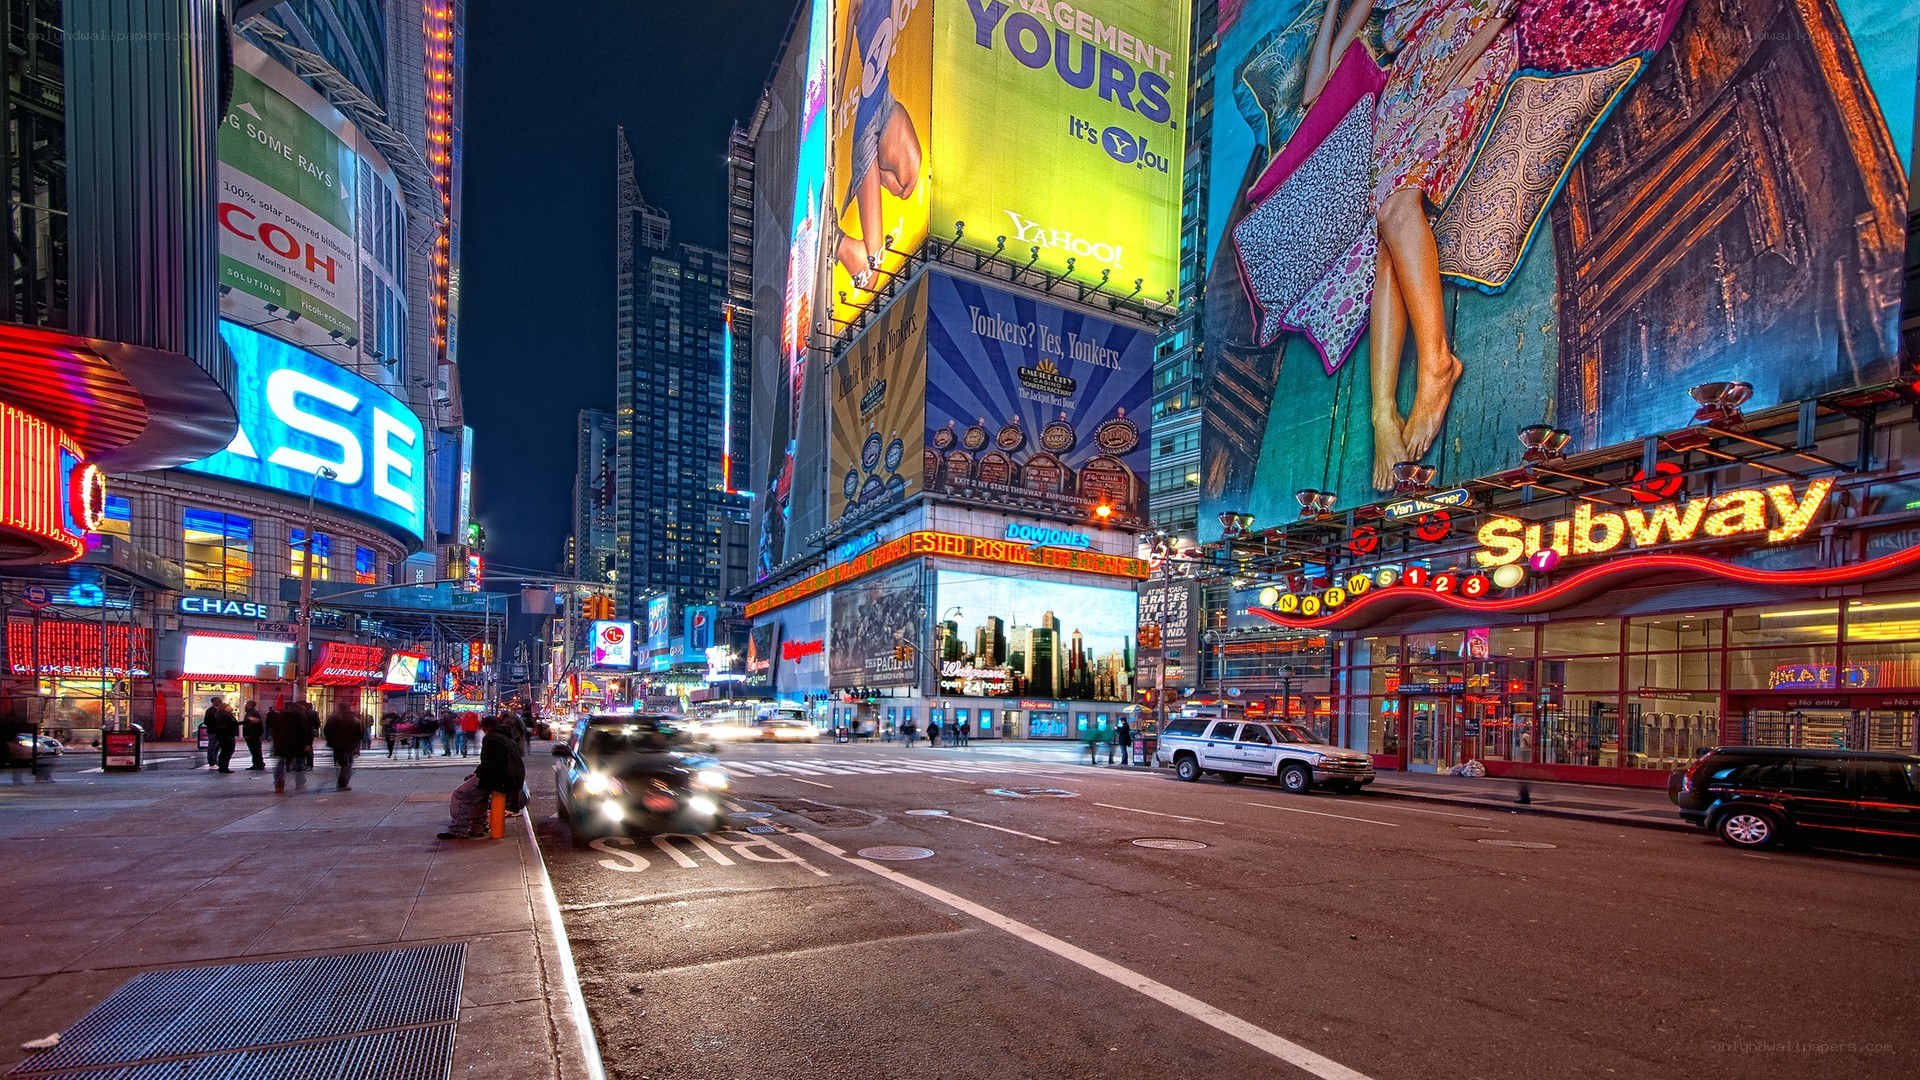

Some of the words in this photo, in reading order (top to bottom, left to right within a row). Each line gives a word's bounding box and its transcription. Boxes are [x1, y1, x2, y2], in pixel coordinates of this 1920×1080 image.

[1005, 0, 1175, 79] NAGEMENT.
[967, 0, 1177, 130] YOURS.
[1069, 115, 1098, 145] It's
[246, 123, 292, 161] SOME
[298, 154, 332, 188] RAYS
[223, 181, 256, 204] 100%
[259, 200, 283, 217] solar
[285, 214, 320, 240] powered
[321, 234, 353, 262] billboard.
[1004, 209, 1123, 269] YAHOO!
[227, 268, 281, 297] SOLUTIONS
[257, 253, 286, 273] Moving
[288, 267, 308, 284] Ideas
[309, 278, 336, 298] Forward
[301, 301, 352, 333] ricoh-eco.com
[969, 305, 1036, 348] Yonkers?
[1039, 324, 1064, 360] Yes,
[1067, 332, 1122, 371] Yonkers.
[1022, 381, 1047, 391] YONKERS
[1047, 387, 1072, 397] RACEWAY
[1033, 378, 1062, 388] CASINO
[954, 476, 970, 486] EXIT
[971, 479, 977, 487] 2
[978, 481, 989, 490] NY
[990, 483, 1009, 492] STATE
[1010, 486, 1042, 498] THRUWAY
[1393, 504, 1413, 516] Van
[1474, 477, 1836, 568] Subway
[1537, 551, 1550, 568] 7
[1150, 592, 1188, 603] RACES
[1282, 597, 1292, 609] N
[1304, 600, 1315, 614] Q
[1329, 590, 1340, 603] R
[1350, 578, 1365, 591] W
[1380, 570, 1391, 584] S
[1409, 570, 1418, 584] 1
[1436, 576, 1449, 591] 2
[1467, 578, 1481, 592] 3
[181, 597, 267, 618] CHASE
[649, 602, 668, 618] HAPPY
[1179, 601, 1187, 609] A
[269, 624, 280, 632] 42
[941, 661, 1007, 680] Walgreens
[940, 680, 962, 690] open
[963, 680, 981, 693] 24
[982, 681, 1007, 690] hours
